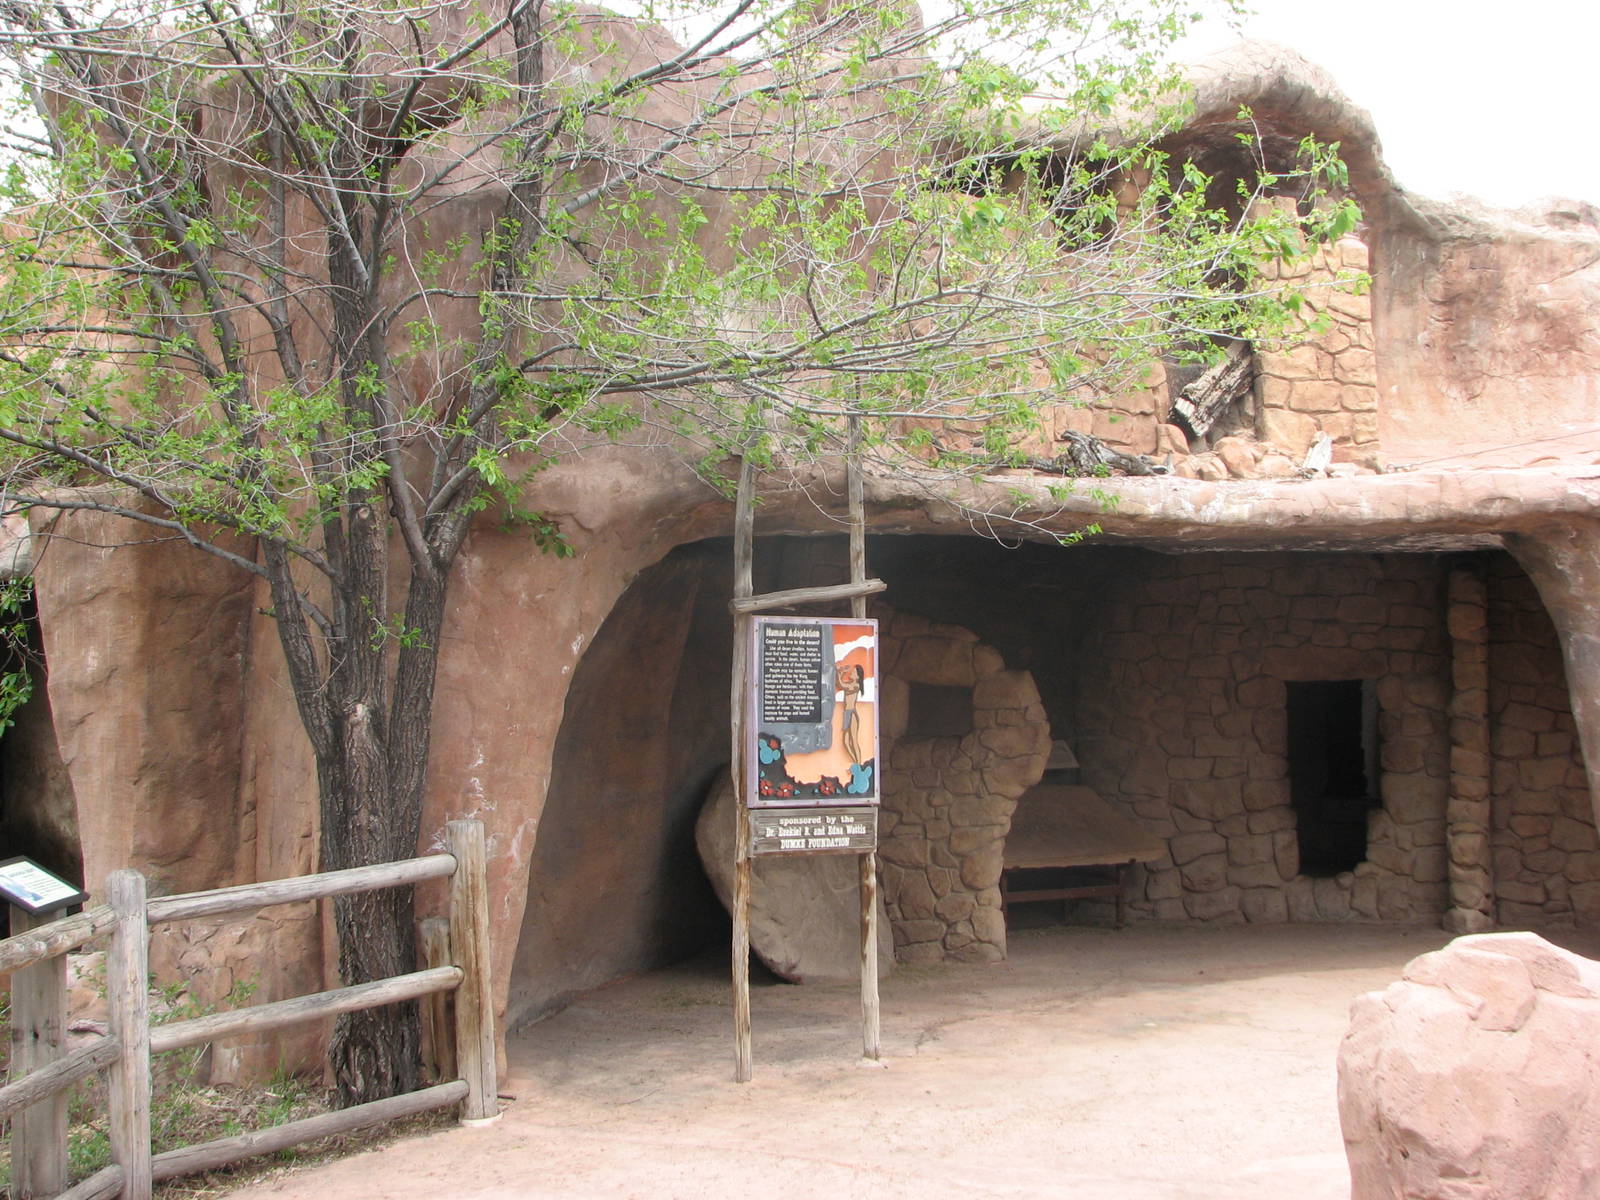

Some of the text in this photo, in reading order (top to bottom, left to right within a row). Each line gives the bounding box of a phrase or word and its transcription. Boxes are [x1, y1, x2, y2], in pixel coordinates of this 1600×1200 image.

[766, 627, 820, 639] Human Adaptation
[779, 816, 854, 826] sponsored by the
[778, 826, 802, 837] Ezekiel
[814, 826, 826, 836] and
[828, 824, 844, 836] Edna
[780, 836, 850, 850] DUMKE FOUNDATION
